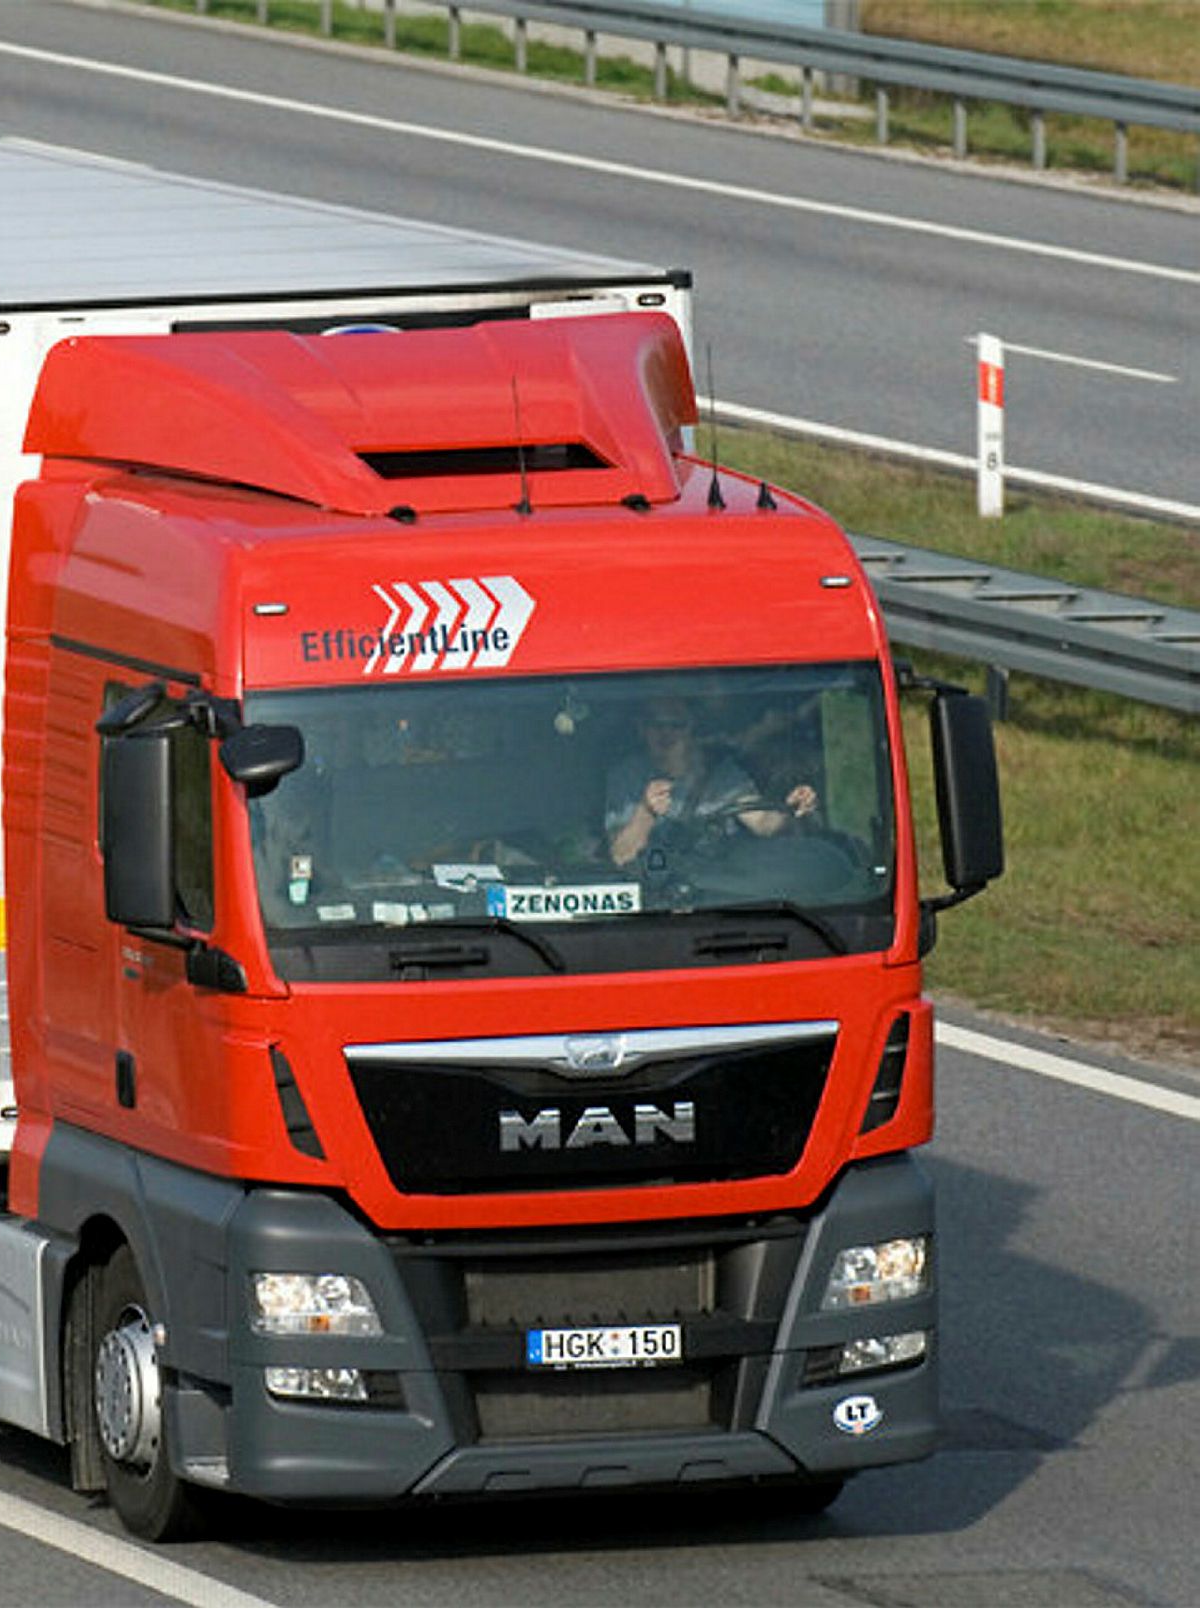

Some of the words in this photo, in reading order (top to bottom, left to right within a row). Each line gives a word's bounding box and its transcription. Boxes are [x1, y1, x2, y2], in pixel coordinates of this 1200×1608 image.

[300, 624, 510, 663] EfficientLine
[511, 892, 634, 914] ZENONAS
[499, 1102, 695, 1150] MAN
[544, 1332, 604, 1359] HGK
[629, 1330, 676, 1356] 150
[845, 1402, 871, 1421] LT
